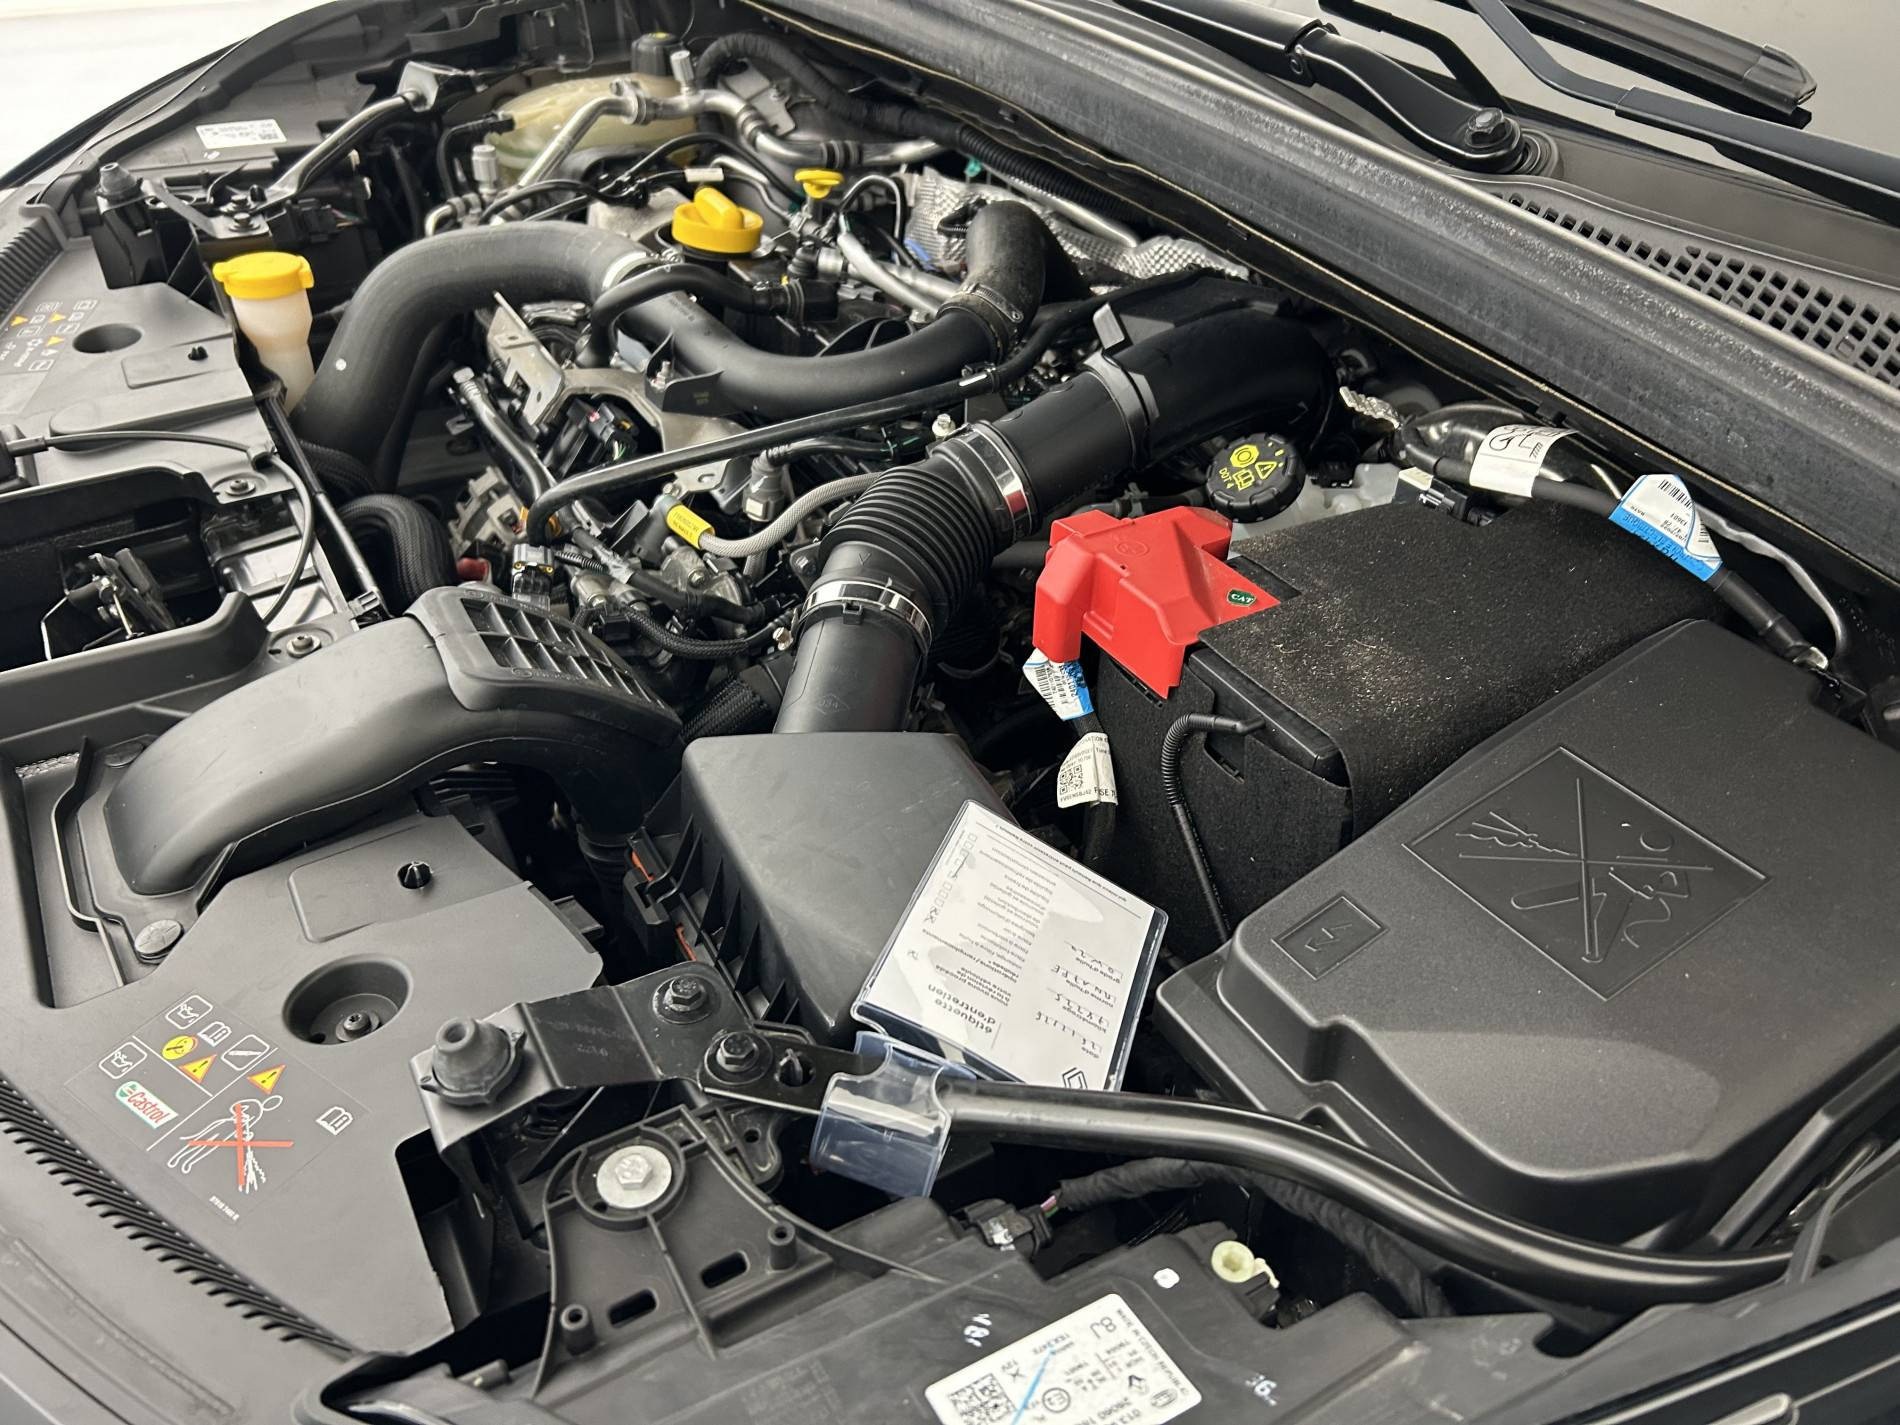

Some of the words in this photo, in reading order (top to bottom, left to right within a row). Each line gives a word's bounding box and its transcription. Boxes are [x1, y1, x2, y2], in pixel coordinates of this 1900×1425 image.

[1219, 467, 1232, 482] DOT
[1231, 592, 1255, 606] CAT
[925, 983, 996, 1026] d'entretien
[932, 996, 993, 1035] étiquette
[127, 1089, 170, 1124] Castrol
